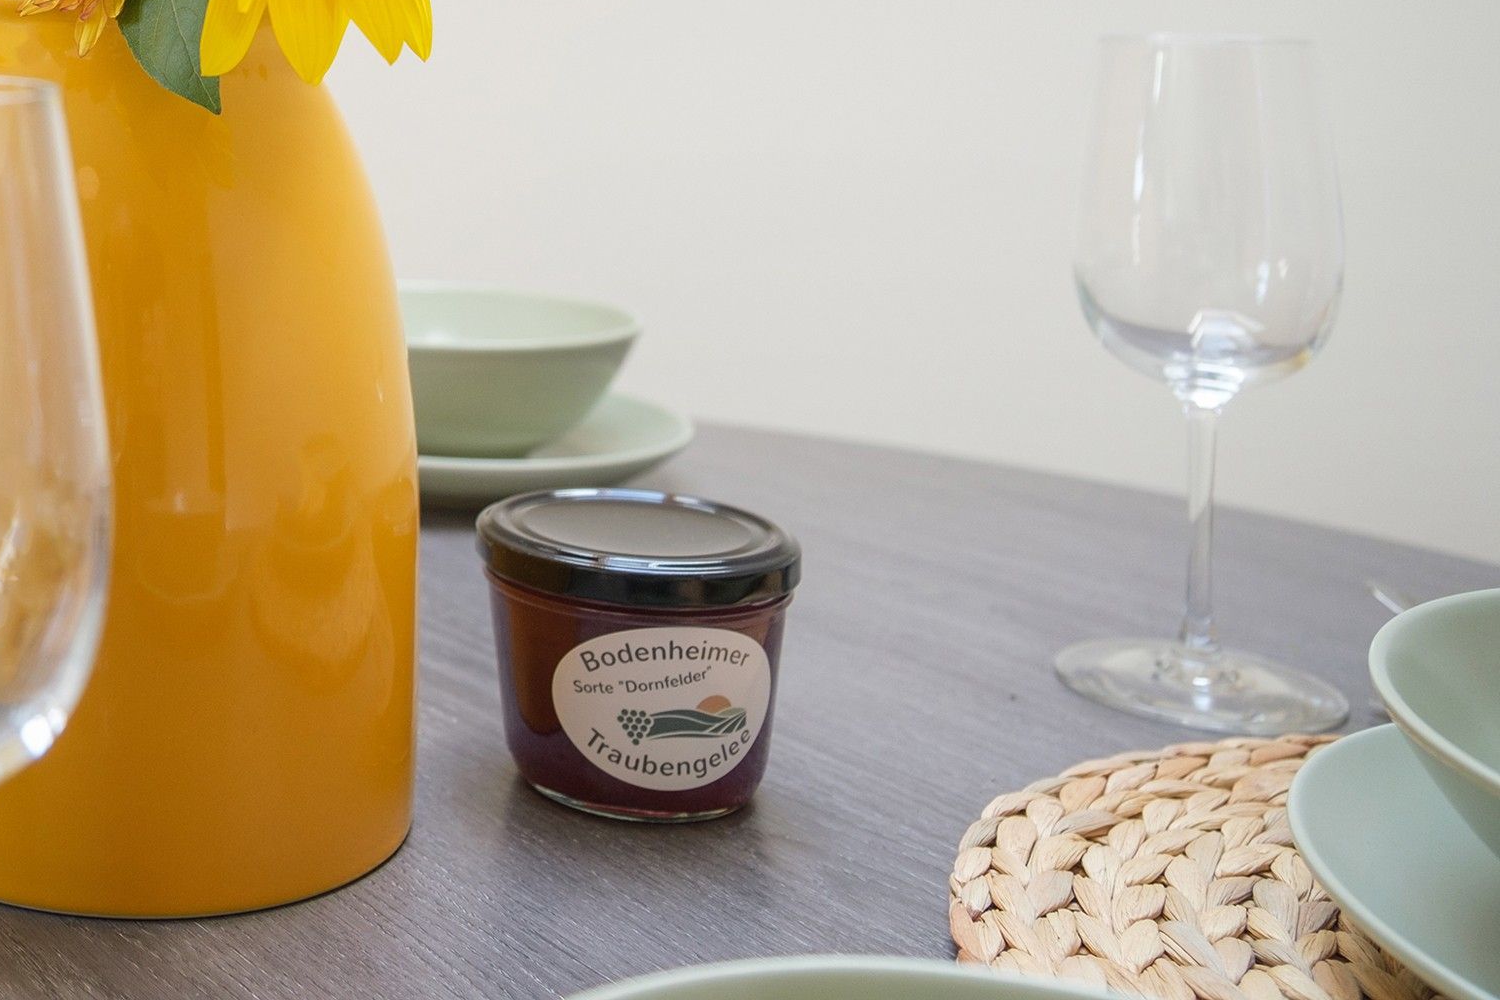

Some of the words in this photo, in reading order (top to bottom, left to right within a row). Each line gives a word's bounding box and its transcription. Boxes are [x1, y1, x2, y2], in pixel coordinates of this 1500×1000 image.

[580, 640, 750, 673] Bodenheimer
[573, 679, 614, 694] Sorte
[619, 665, 713, 694] "Dornfelder"
[587, 727, 751, 778] Traubengelee
